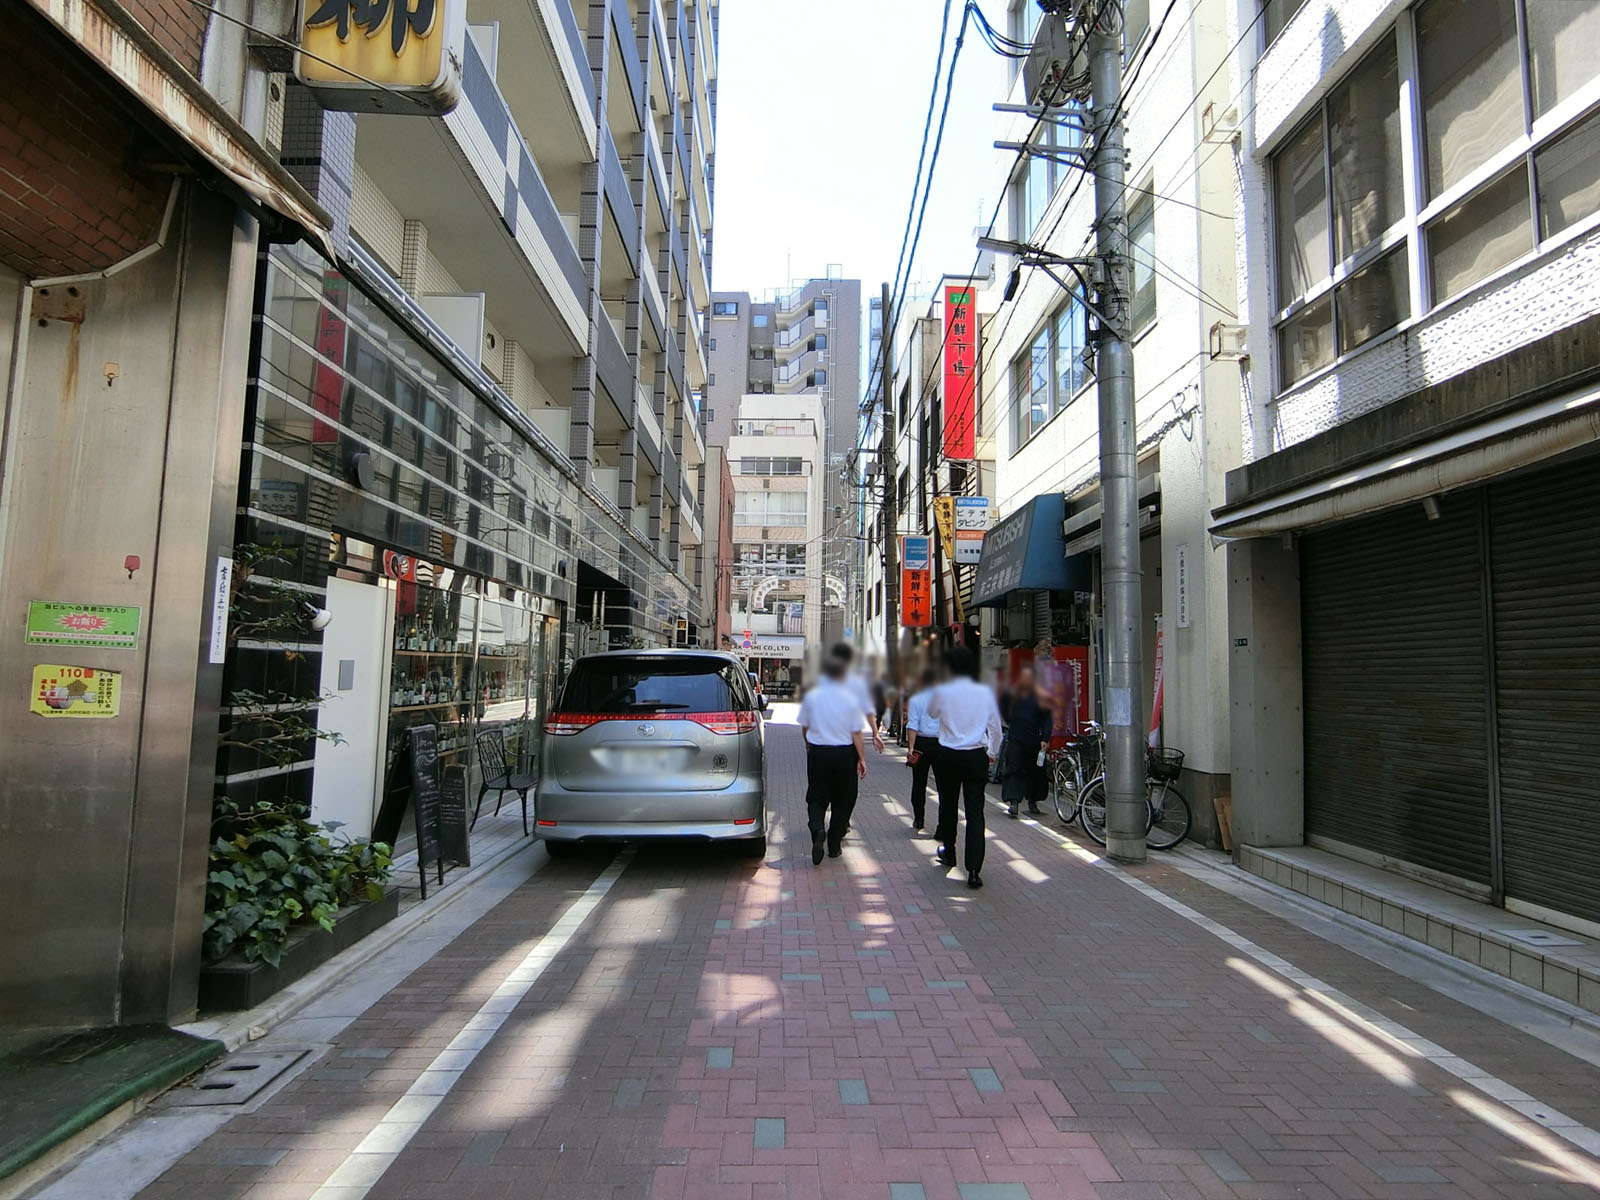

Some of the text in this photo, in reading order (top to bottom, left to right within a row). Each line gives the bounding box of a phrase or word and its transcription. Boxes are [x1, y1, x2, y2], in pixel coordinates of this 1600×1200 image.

[949, 307, 973, 376] 新鮮市場
[957, 509, 986, 518] ビデオ
[957, 520, 986, 528] ダビング
